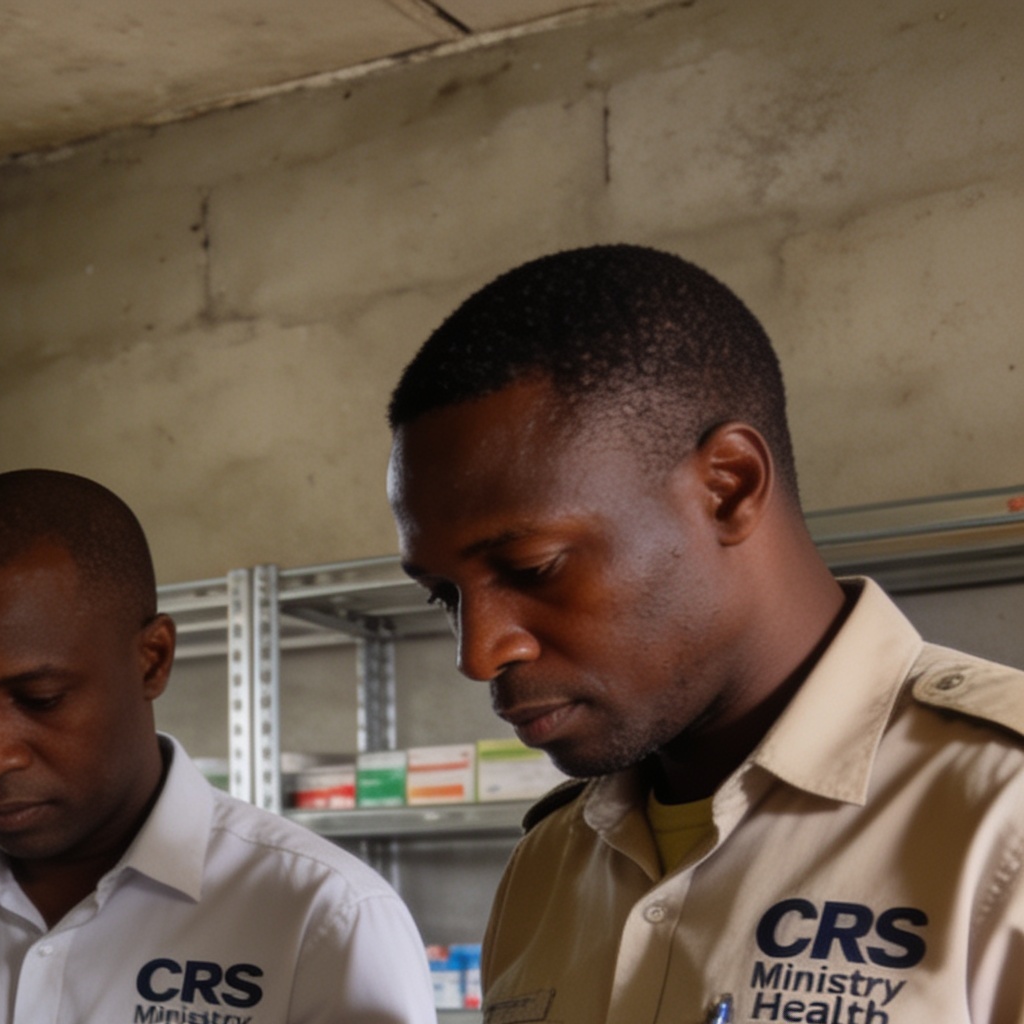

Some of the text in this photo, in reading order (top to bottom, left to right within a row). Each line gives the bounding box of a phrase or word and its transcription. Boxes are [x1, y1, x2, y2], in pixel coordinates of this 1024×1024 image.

[756, 898, 929, 969] CRS
[136, 958, 263, 1008] CRS
[750, 961, 907, 1006] Ministry
